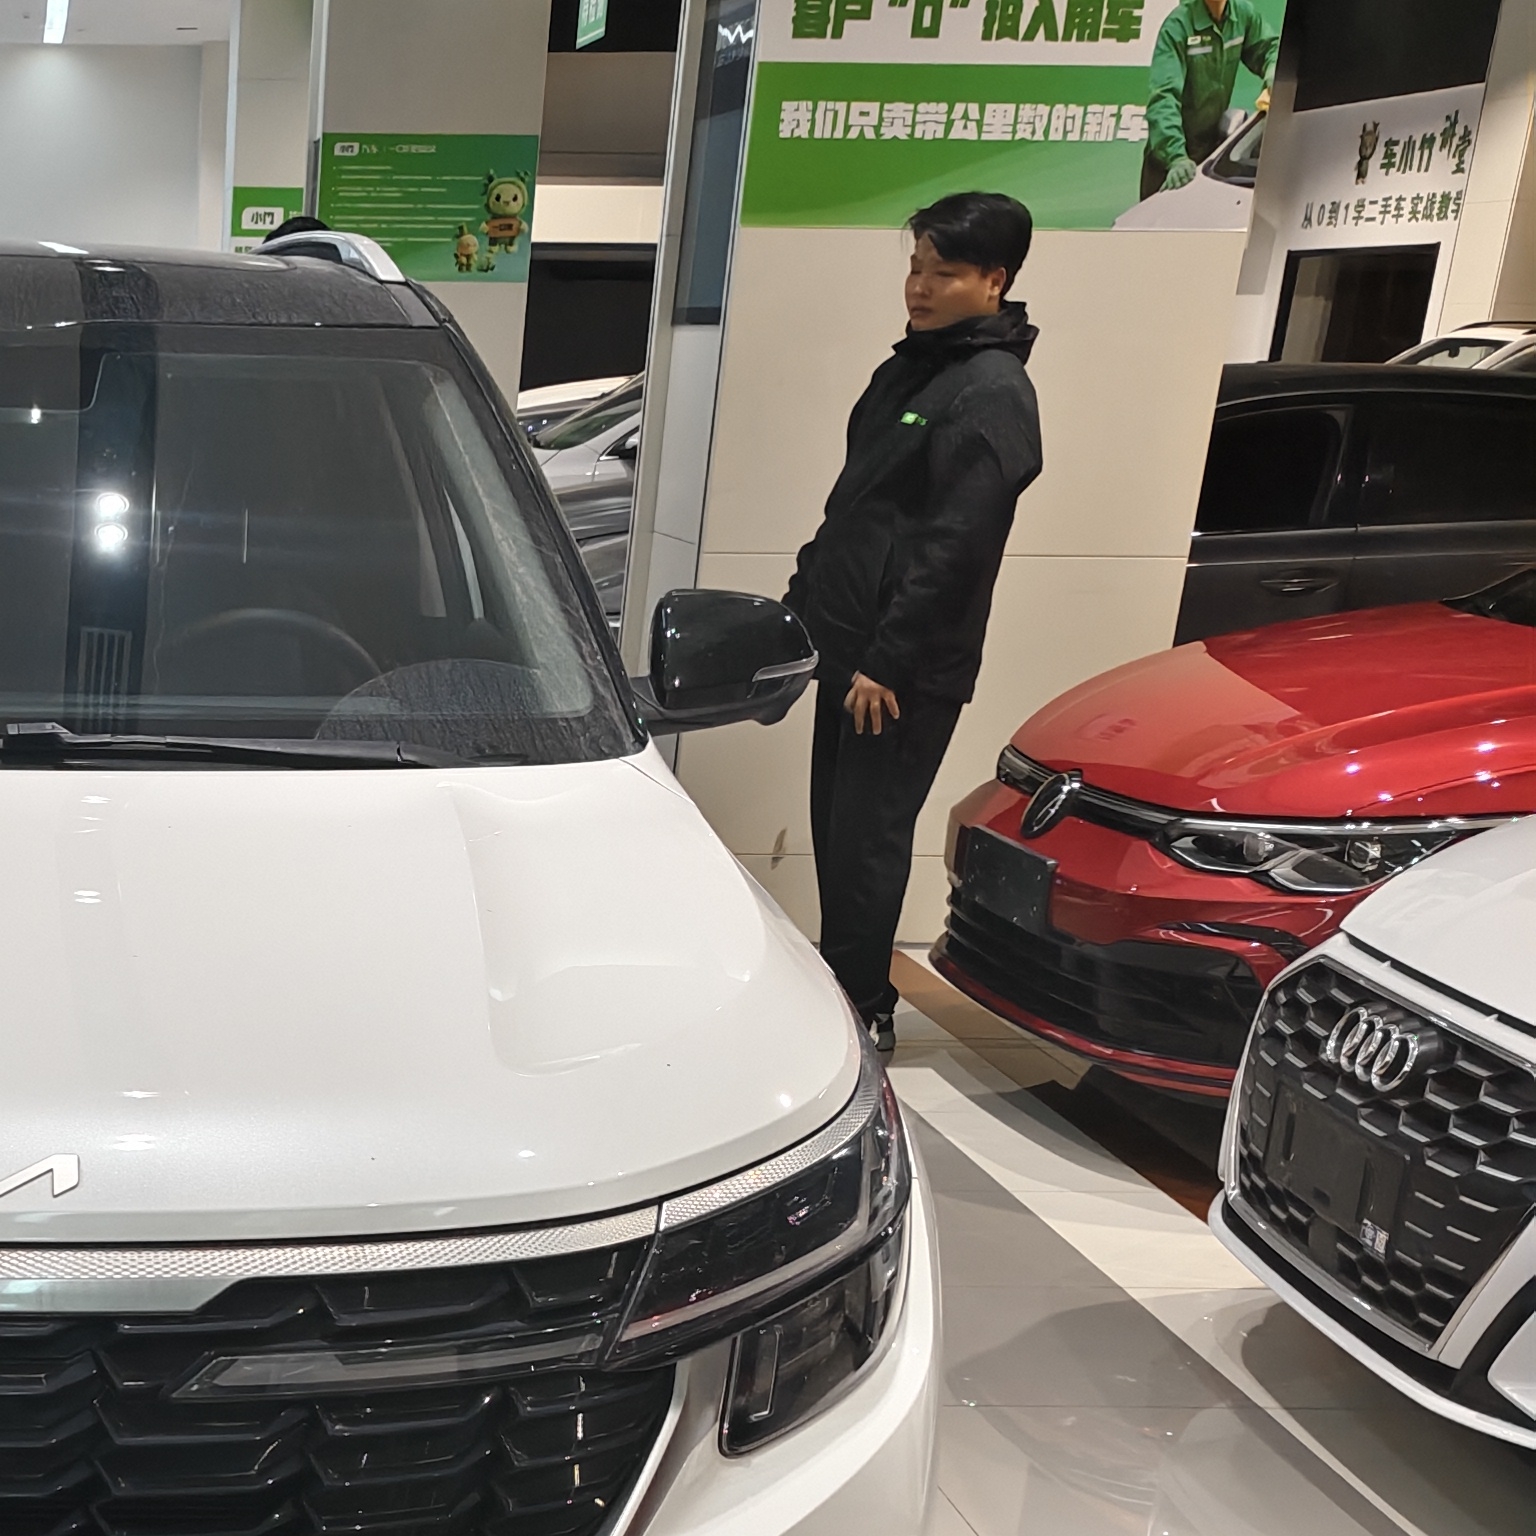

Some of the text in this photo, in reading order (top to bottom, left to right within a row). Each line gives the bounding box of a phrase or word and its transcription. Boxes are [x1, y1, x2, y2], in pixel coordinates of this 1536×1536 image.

[778, 100, 1149, 142] 我们只卖带公里数的新车
